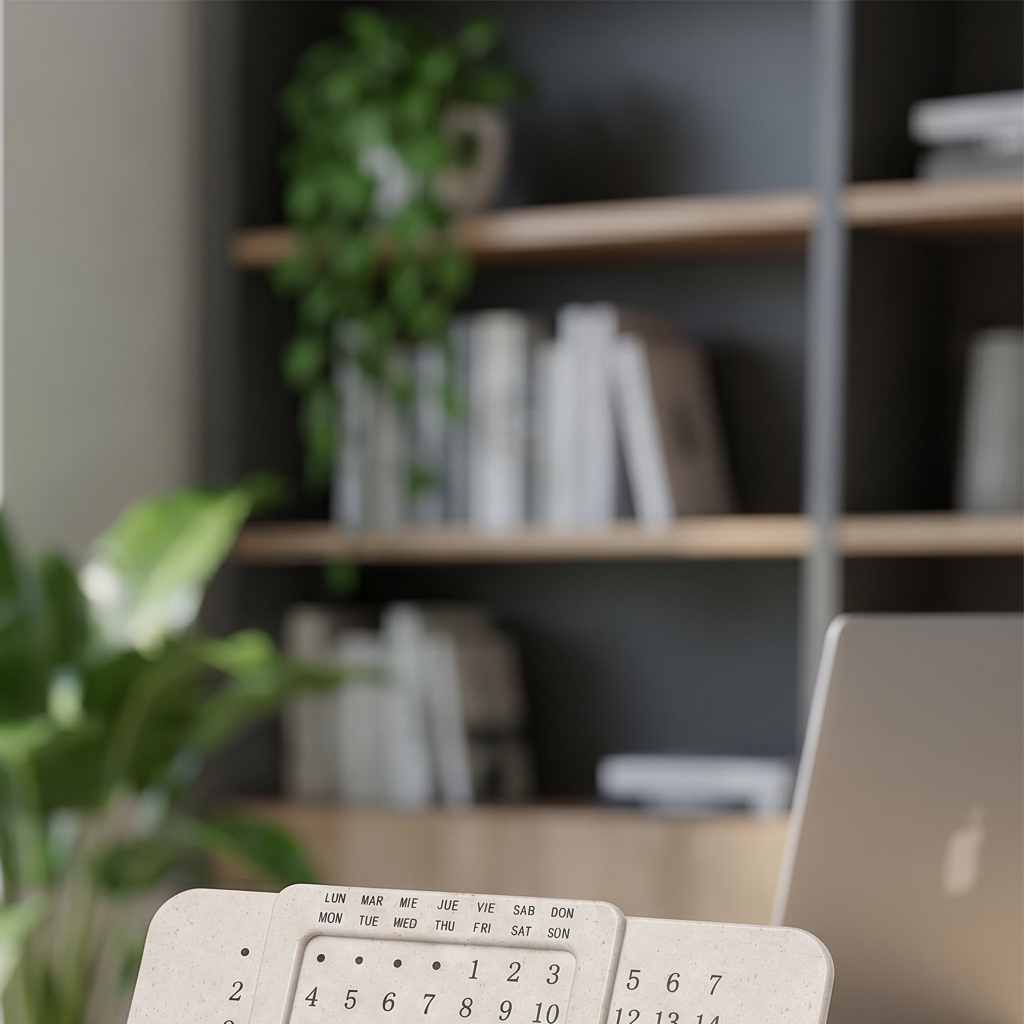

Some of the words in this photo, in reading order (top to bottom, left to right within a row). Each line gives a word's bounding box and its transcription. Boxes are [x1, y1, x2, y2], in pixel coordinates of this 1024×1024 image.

[324, 892, 347, 904] LUN
[360, 894, 384, 906] MAR
[399, 897, 419, 909] MIE
[437, 899, 460, 911] JUE
[477, 901, 496, 914] VIE
[512, 904, 536, 916] SAB
[550, 906, 575, 919] DON
[318, 911, 343, 924] MON
[359, 915, 380, 927] TUE
[435, 919, 456, 932] THU
[473, 922, 492, 934] FRI
[510, 925, 532, 937] SAT
[547, 927, 571, 939] SON
[468, 959, 479, 980] 1
[506, 961, 521, 983] 2
[546, 963, 560, 985] 3
[626, 969, 641, 991] 5
[666, 972, 681, 993] 6
[708, 974, 723, 996] 7
[229, 981, 244, 1002] 2
[304, 986, 318, 1007] 4
[344, 989, 358, 1010] 5
[382, 991, 397, 1012] 6
[422, 993, 436, 1015] 7
[459, 997, 473, 1018] 8
[498, 1000, 513, 1021] 9
[532, 1002, 560, 1024] 10
